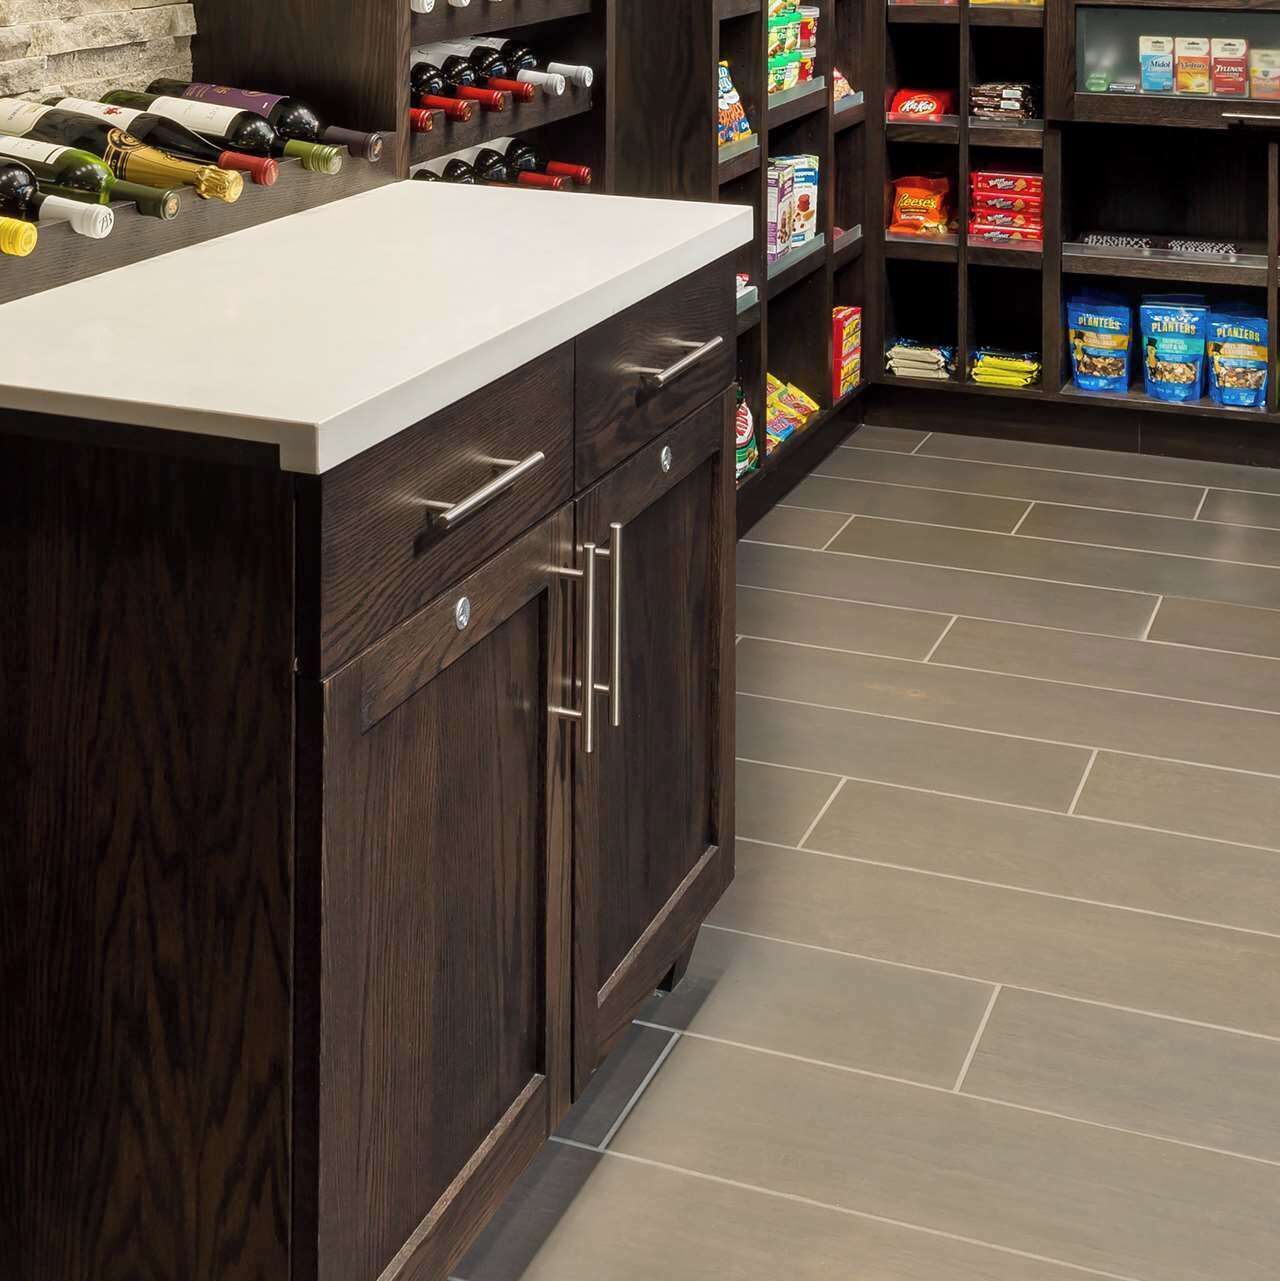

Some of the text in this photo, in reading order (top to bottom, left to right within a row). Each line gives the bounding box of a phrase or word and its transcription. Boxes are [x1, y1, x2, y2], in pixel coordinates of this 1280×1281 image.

[1150, 60, 1171, 68] Midol
[1151, 323, 1197, 335] PLANTERS
[1217, 328, 1260, 343] PLANTERS
